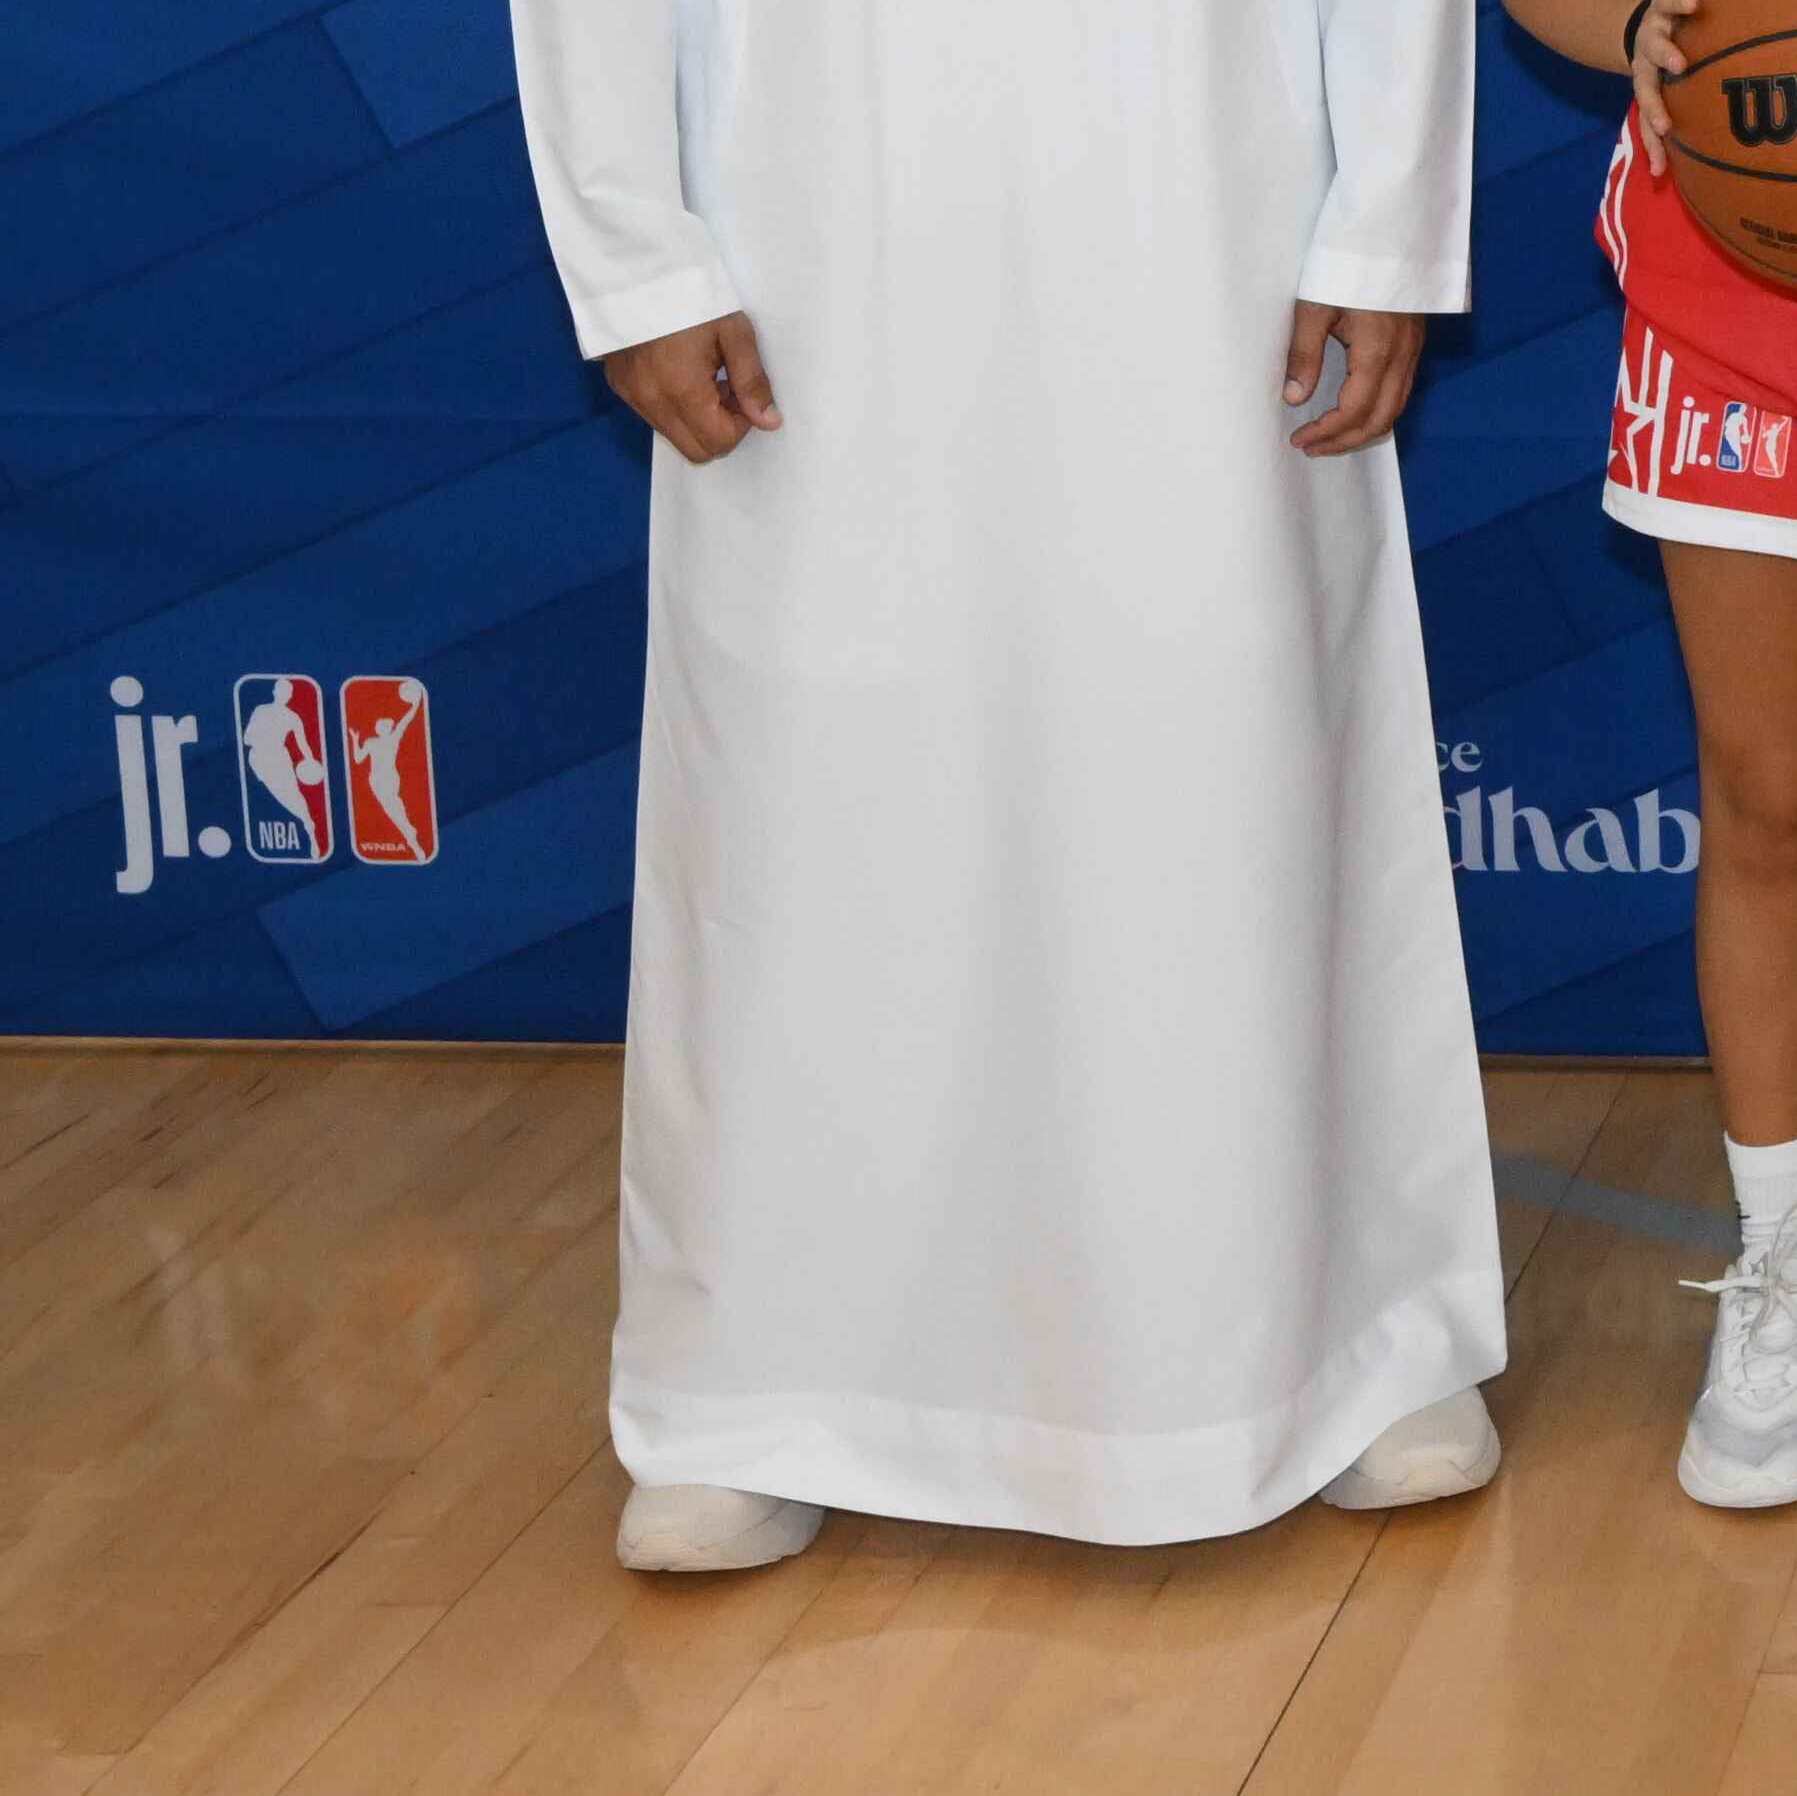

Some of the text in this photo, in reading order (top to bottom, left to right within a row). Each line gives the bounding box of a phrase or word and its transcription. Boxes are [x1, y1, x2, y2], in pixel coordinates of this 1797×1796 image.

[1670, 395, 1712, 475] jr.
[109, 675, 232, 895] jr.
[258, 821, 301, 850] NBA
[359, 842, 407, 853] WNBA
